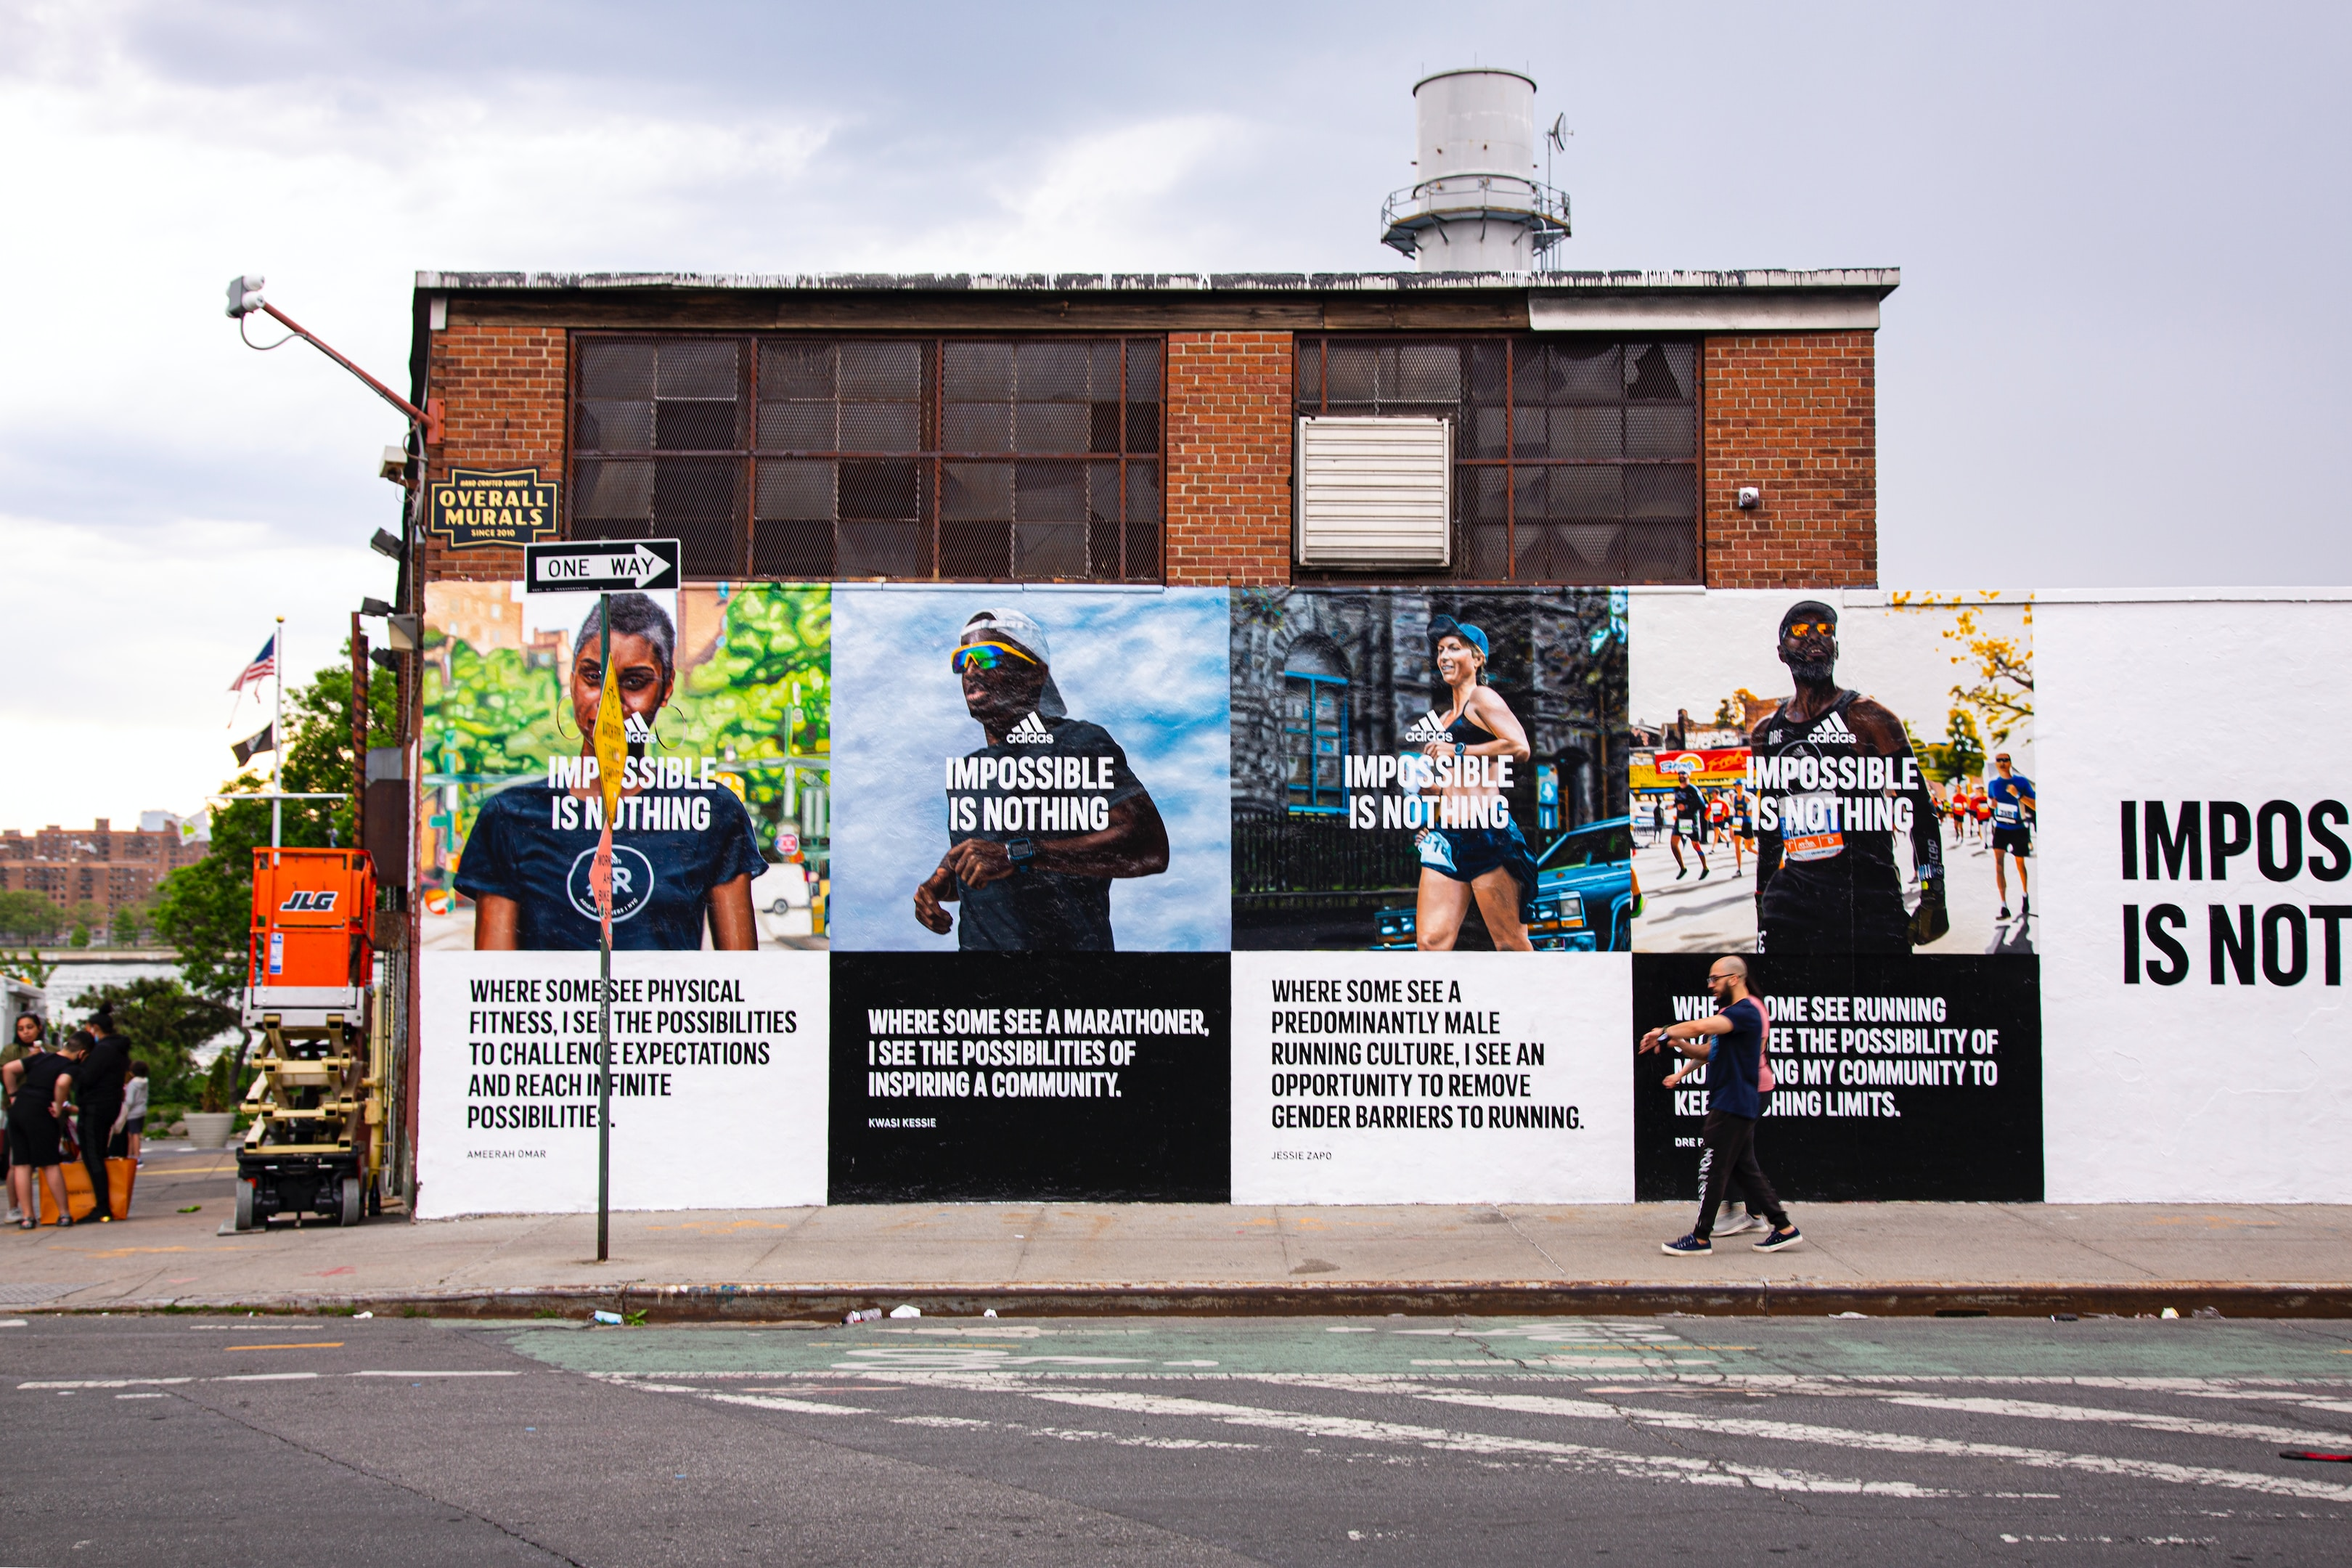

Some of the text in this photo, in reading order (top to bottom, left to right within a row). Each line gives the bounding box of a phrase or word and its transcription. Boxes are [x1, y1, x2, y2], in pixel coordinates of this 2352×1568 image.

[439, 490, 549, 507] OVERALL
[445, 509, 543, 526] MURALS
[471, 528, 515, 537] SINCE 2010
[548, 557, 655, 578] ONE WAY
[625, 730, 657, 743] idas
[1006, 730, 1054, 744] adidas
[1405, 729, 1453, 743] adidas
[1768, 729, 1783, 746] DRE
[1807, 730, 1857, 744] adidas
[548, 756, 717, 790] IMPSSIBLE
[946, 757, 1114, 790] IMPOSSIBLE
[1344, 754, 1514, 788] IMPOSSIBLE
[1747, 756, 1919, 790] IMPOSSIBLE
[552, 796, 579, 830] IS
[950, 796, 1109, 831] IS NOTHING
[1349, 795, 1509, 829] IS NOTHING
[1752, 796, 1779, 831] IS
[1785, 796, 1914, 831] NOTHING
[2120, 800, 2351, 882] IMPOS
[280, 891, 338, 911] JLG
[2123, 903, 2352, 987] IS NOT
[470, 979, 745, 1003] WHERE SOME SEE PHYSICAL
[1272, 980, 1461, 1003] WHERE SOME SEE A
[1672, 996, 1946, 1023] WHE OME SEE RUNNING
[470, 1010, 797, 1036] FITNESS, I SE THE POSSIBILITIES
[868, 1009, 1209, 1037] WHERE SOME SEE A MARATHONER,
[1272, 1011, 1500, 1034] PREDOMINANTLY MALE
[470, 1042, 494, 1065] TO
[623, 1042, 769, 1065] EXPECTATIONS
[868, 1040, 1136, 1066] I SEE THE POSSIBILITIES OF
[1767, 1028, 1998, 1055] EE THE POSSIBILITY OF
[1272, 1042, 1544, 1068] RUNNING CULTURE, I SEE AN
[468, 1074, 671, 1096] AND REACH INFINITE
[868, 1071, 1122, 1098] INSPIRING A COMMUNITY.
[1803, 1060, 1835, 1085] MY
[1839, 1060, 1967, 1086] COMMUNITY
[1970, 1061, 1998, 1086] TO
[1272, 1074, 1531, 1097] OPPORTUNITY TO REMOVE
[1675, 1090, 1900, 1117] KEE HING LIMITS.
[868, 1118, 936, 1128] KWASI KESSIE
[1272, 1106, 1584, 1130] GENDER BARRIERS TO RUNNING.
[467, 1150, 546, 1159] AMEERAH OMAR
[1675, 1138, 1696, 1147] DRE
[1271, 1151, 1332, 1161] JESSIE ZAPO
